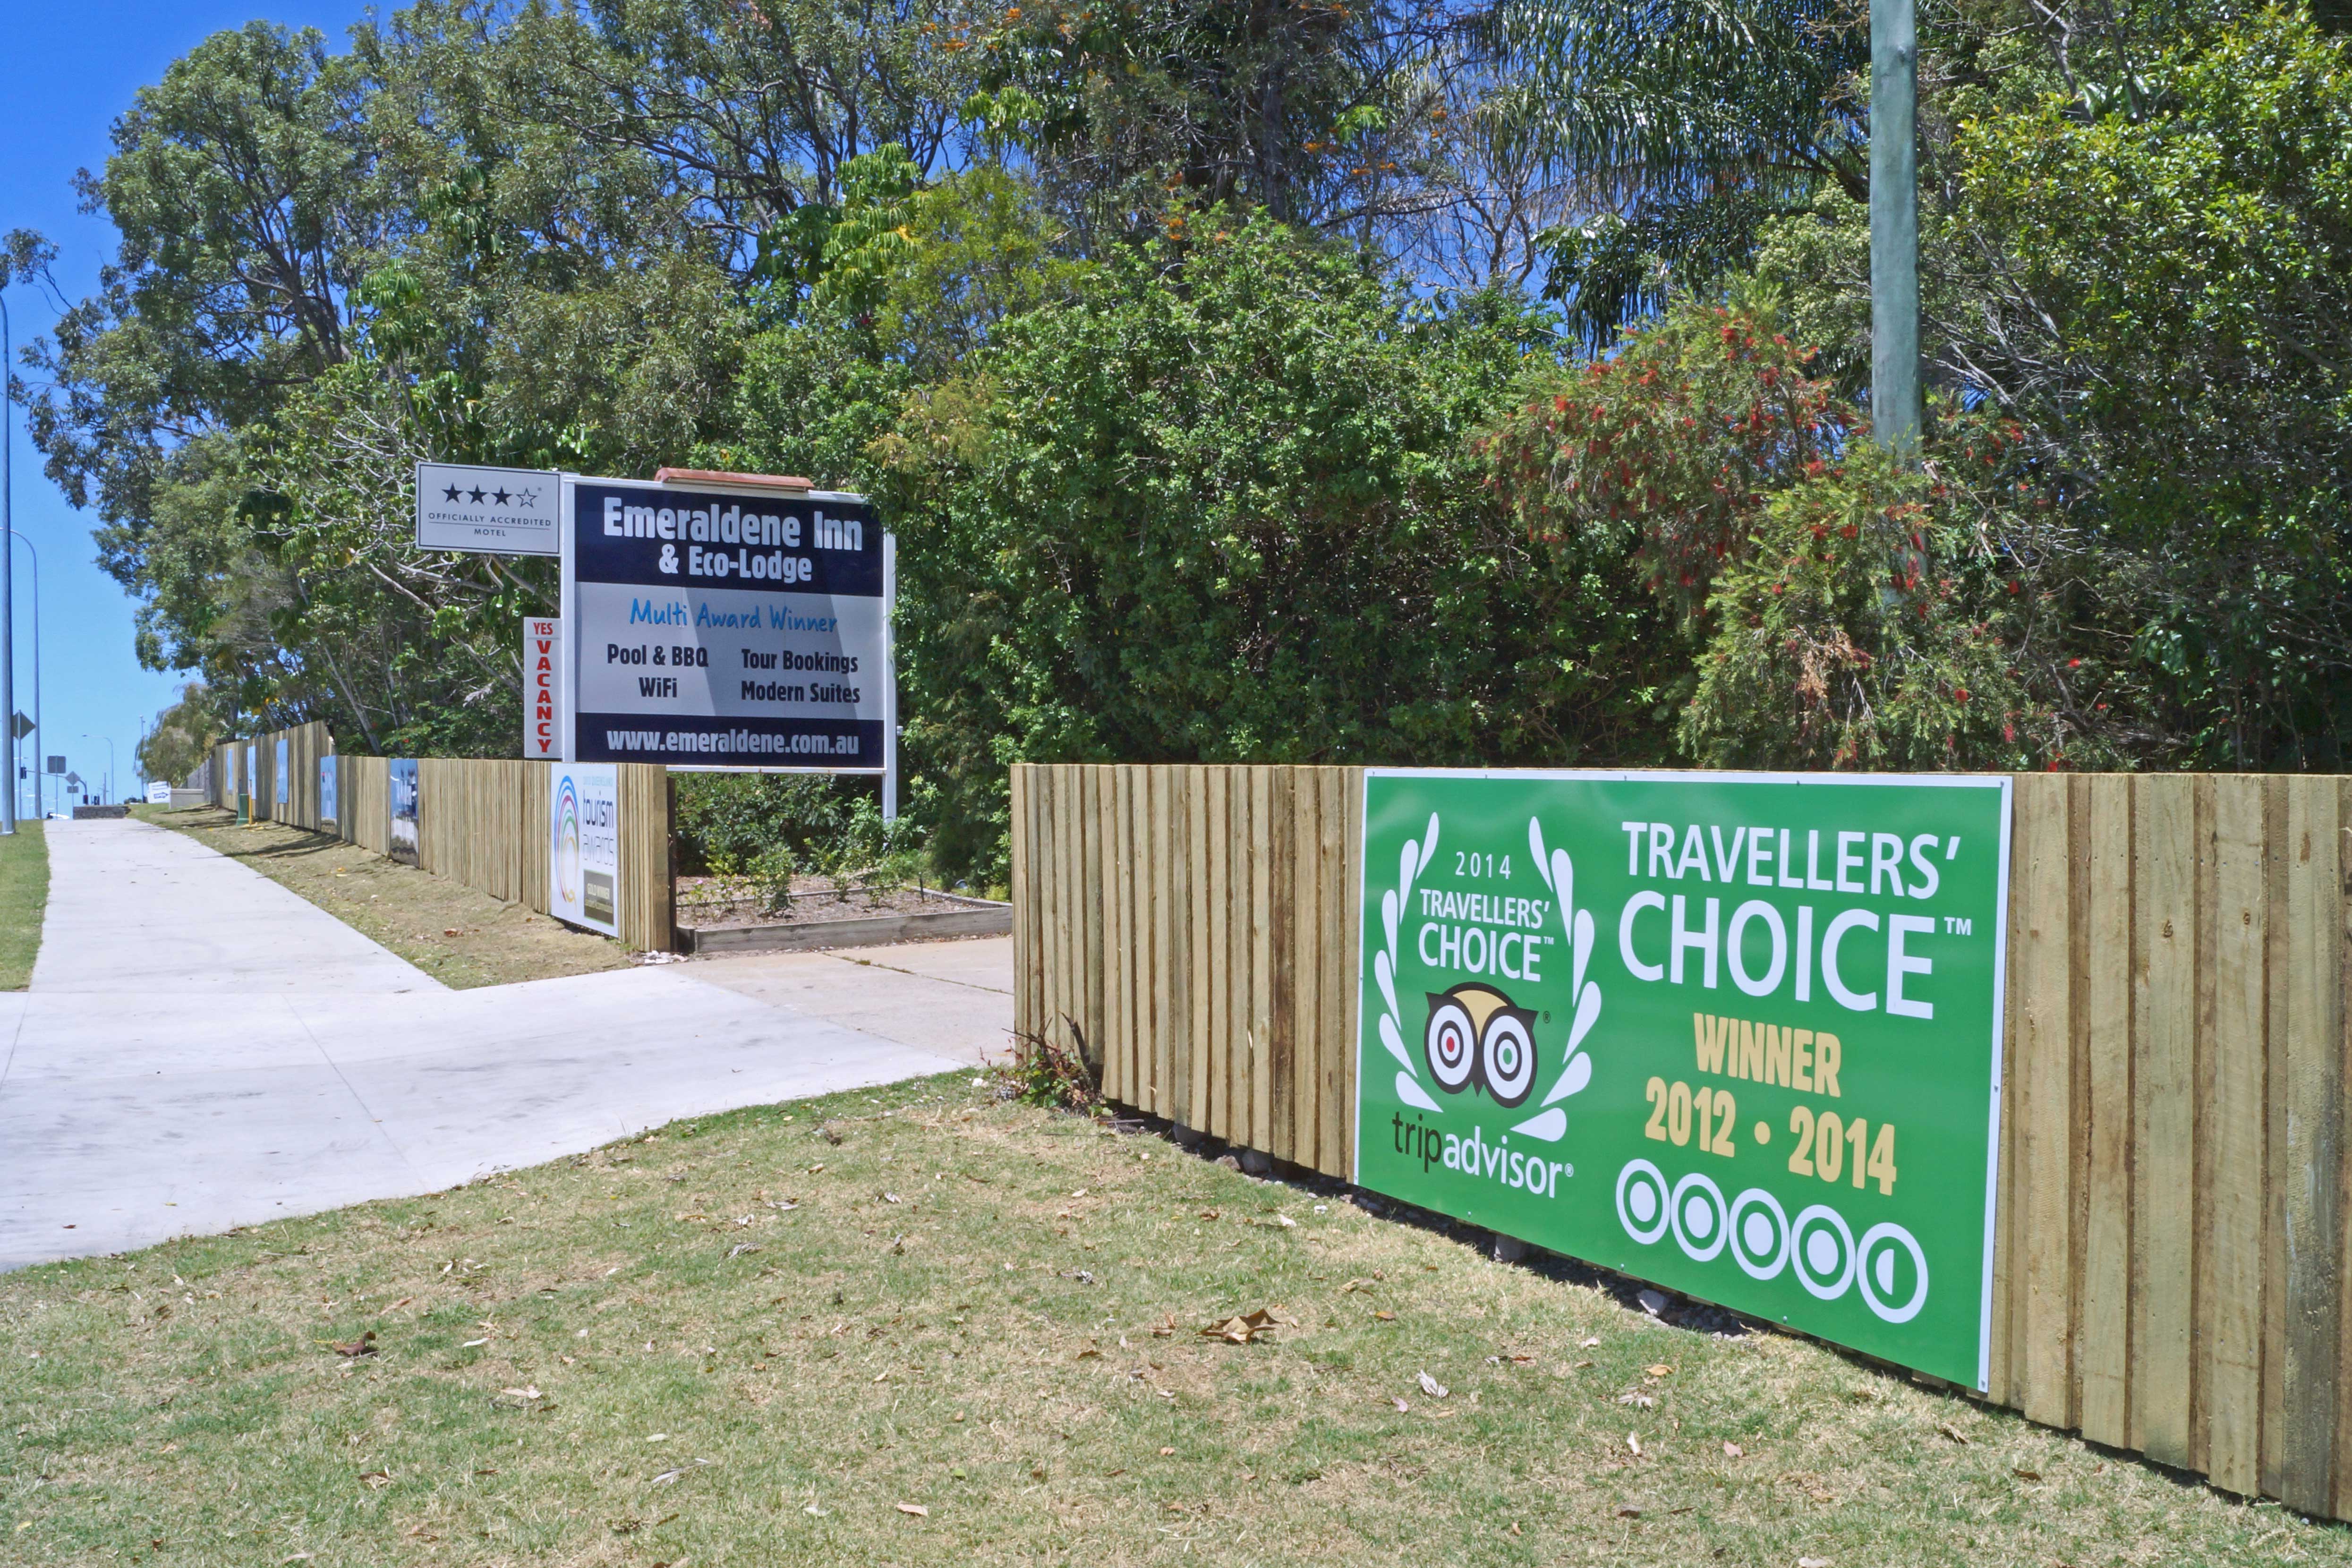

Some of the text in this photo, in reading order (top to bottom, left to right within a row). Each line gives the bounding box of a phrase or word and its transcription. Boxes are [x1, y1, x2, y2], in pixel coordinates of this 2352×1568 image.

[428, 512, 552, 526] OFFICIALLY ACCREDITED
[474, 528, 506, 537] MOTEL
[604, 496, 862, 551] Emeraldene Inn
[658, 543, 812, 584] & Eco-Lodge
[533, 622, 553, 635] YES
[629, 597, 838, 632] Multi Award Winner
[607, 644, 709, 667] Pool & BBQ
[741, 648, 858, 674] Tour Bookings
[537, 640, 552, 753] VACANCY
[639, 677, 677, 698] WiFi
[741, 681, 861, 704] Modern Suites
[606, 729, 859, 755] www.emeraldene.com.au
[583, 790, 614, 828] tourism
[583, 830, 614, 866] awards
[1456, 852, 1511, 879] 2014
[1419, 922, 1541, 982] CHOICE
[1619, 890, 1935, 1020] CHOICE
[1694, 1013, 1841, 1098] WINNER
[1645, 1076, 1737, 1158] 2012
[1788, 1105, 1897, 1196] 2014
